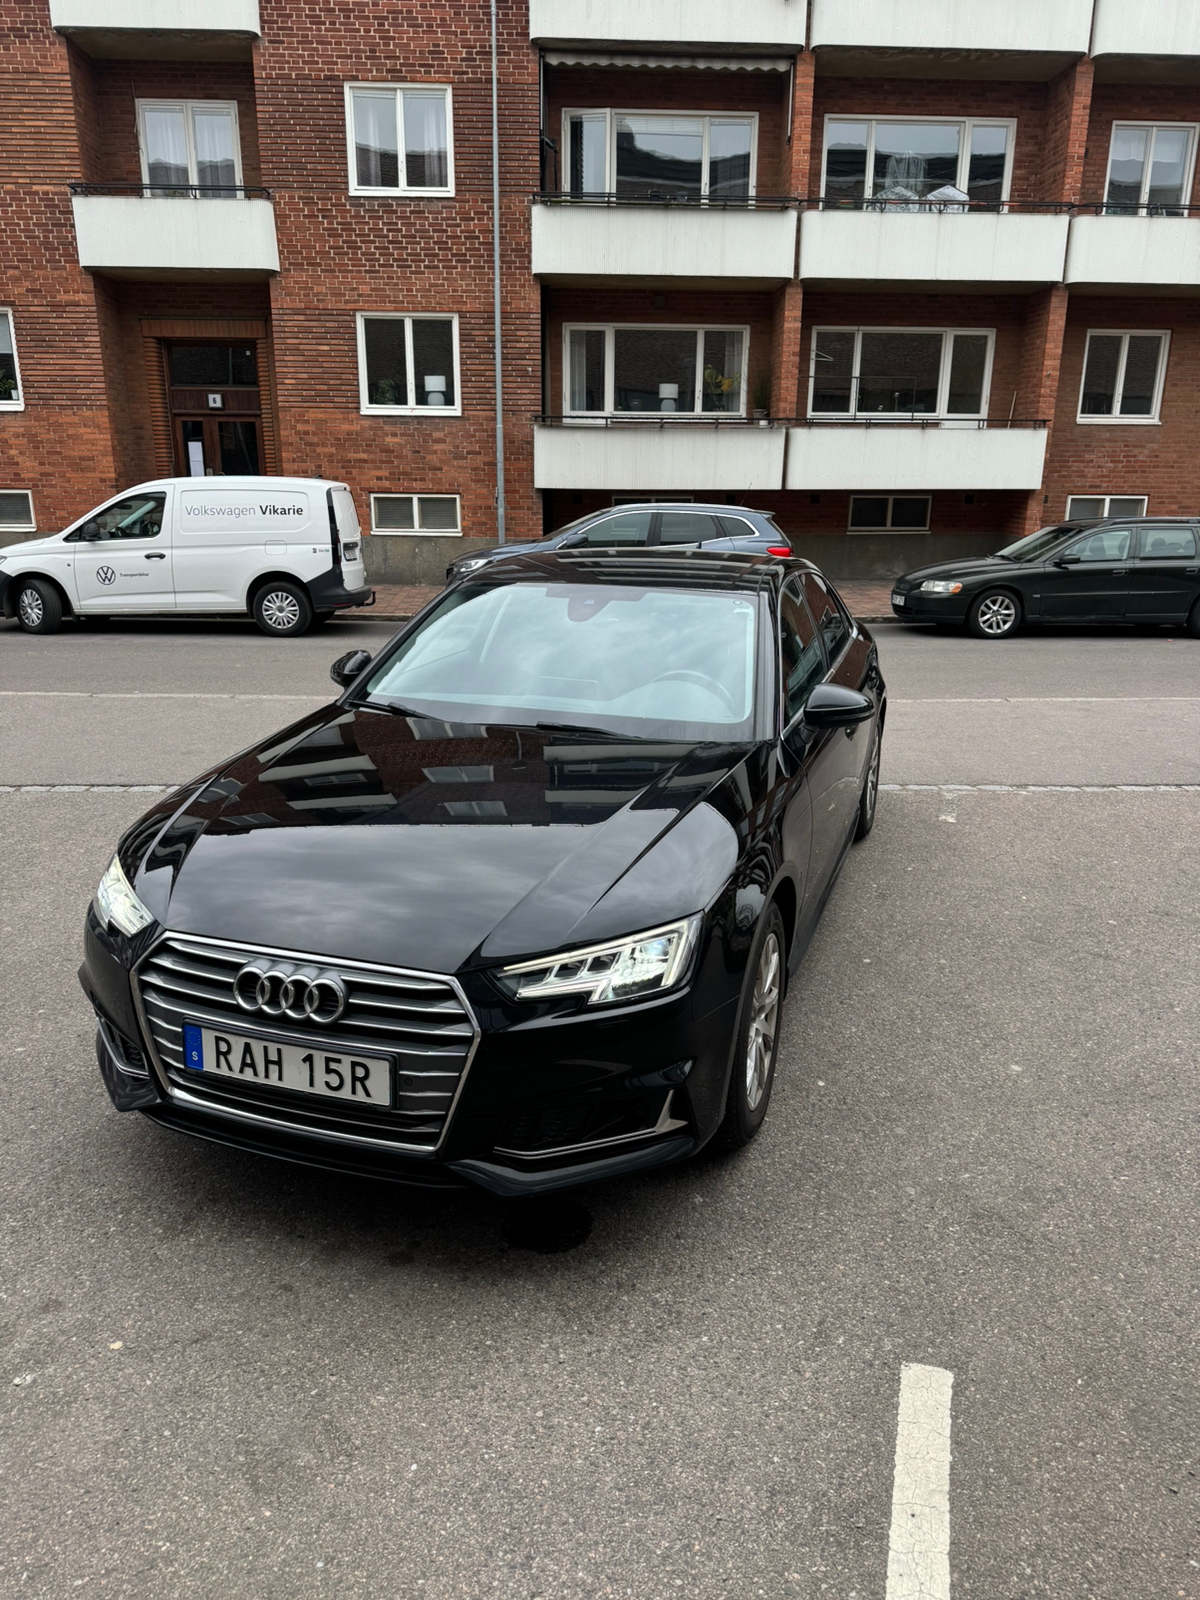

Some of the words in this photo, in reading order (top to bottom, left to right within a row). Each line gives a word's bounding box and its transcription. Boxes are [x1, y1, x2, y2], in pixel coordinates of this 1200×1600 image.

[185, 505, 256, 519] Volkswagen
[259, 504, 304, 516] Vikarie
[96, 565, 117, 586] VW
[191, 1051, 199, 1061] S
[214, 1035, 284, 1082] RAH
[301, 1053, 372, 1098] 15R
